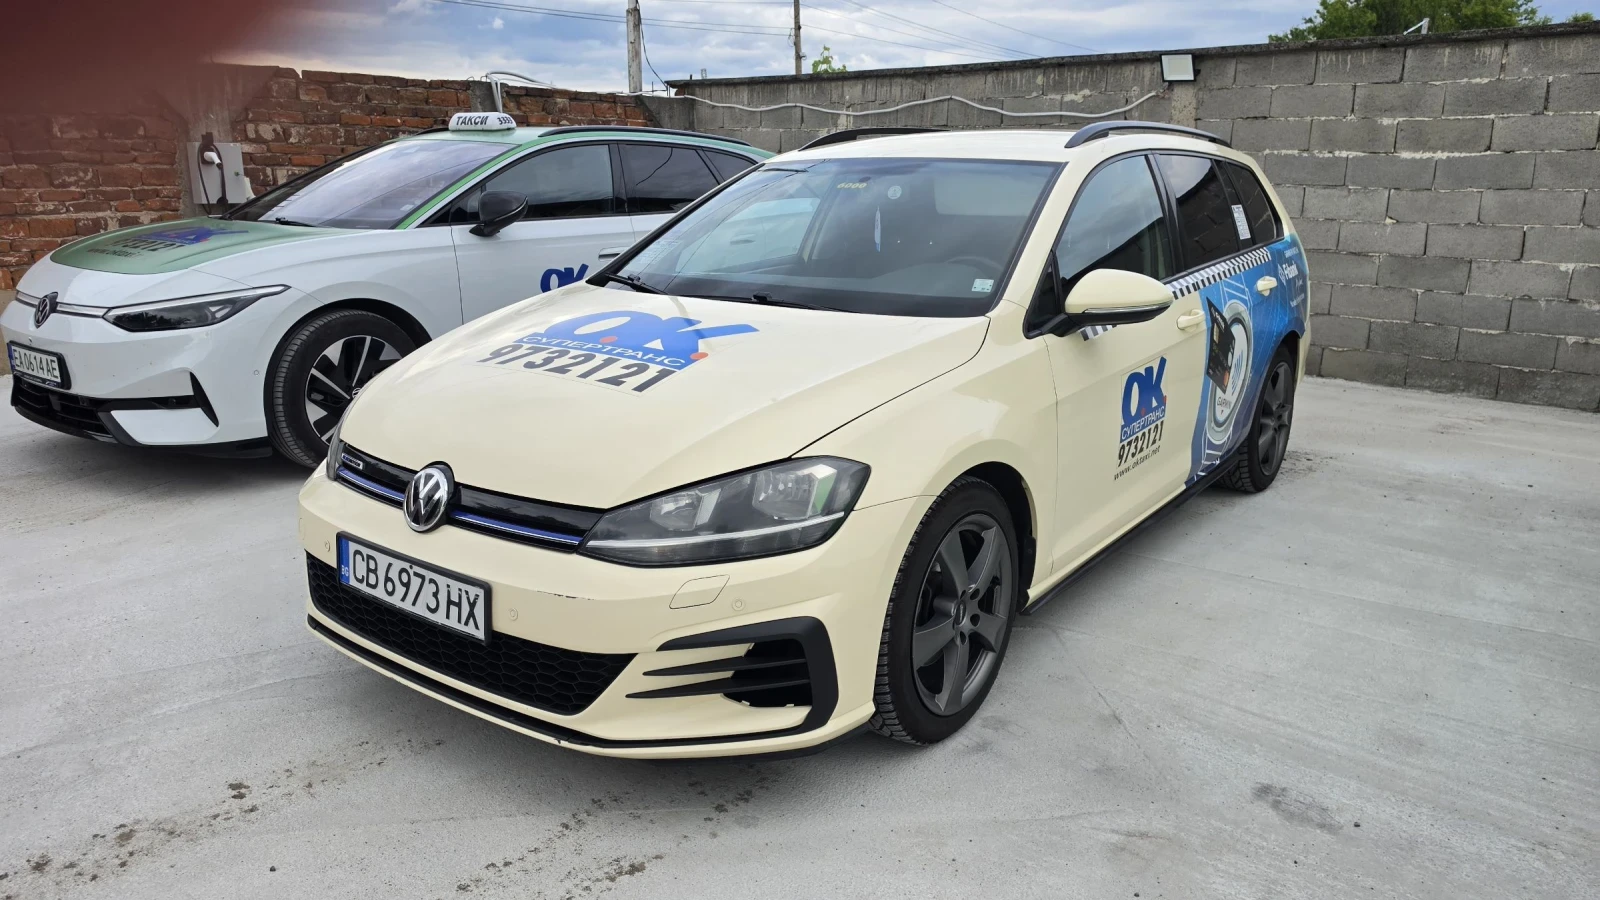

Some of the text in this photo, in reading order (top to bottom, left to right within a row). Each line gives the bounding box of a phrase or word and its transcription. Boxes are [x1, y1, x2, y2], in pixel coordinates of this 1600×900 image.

[456, 115, 489, 126] ТАКСИ
[476, 343, 678, 393] 9732121
[522, 335, 686, 367] СУПЕРТРАНС
[1121, 406, 1165, 440] СУПЕРТРАНС
[1117, 420, 1165, 468] 9732121
[1113, 445, 1161, 481] www.oktaxi.net
[341, 564, 350, 578] BG
